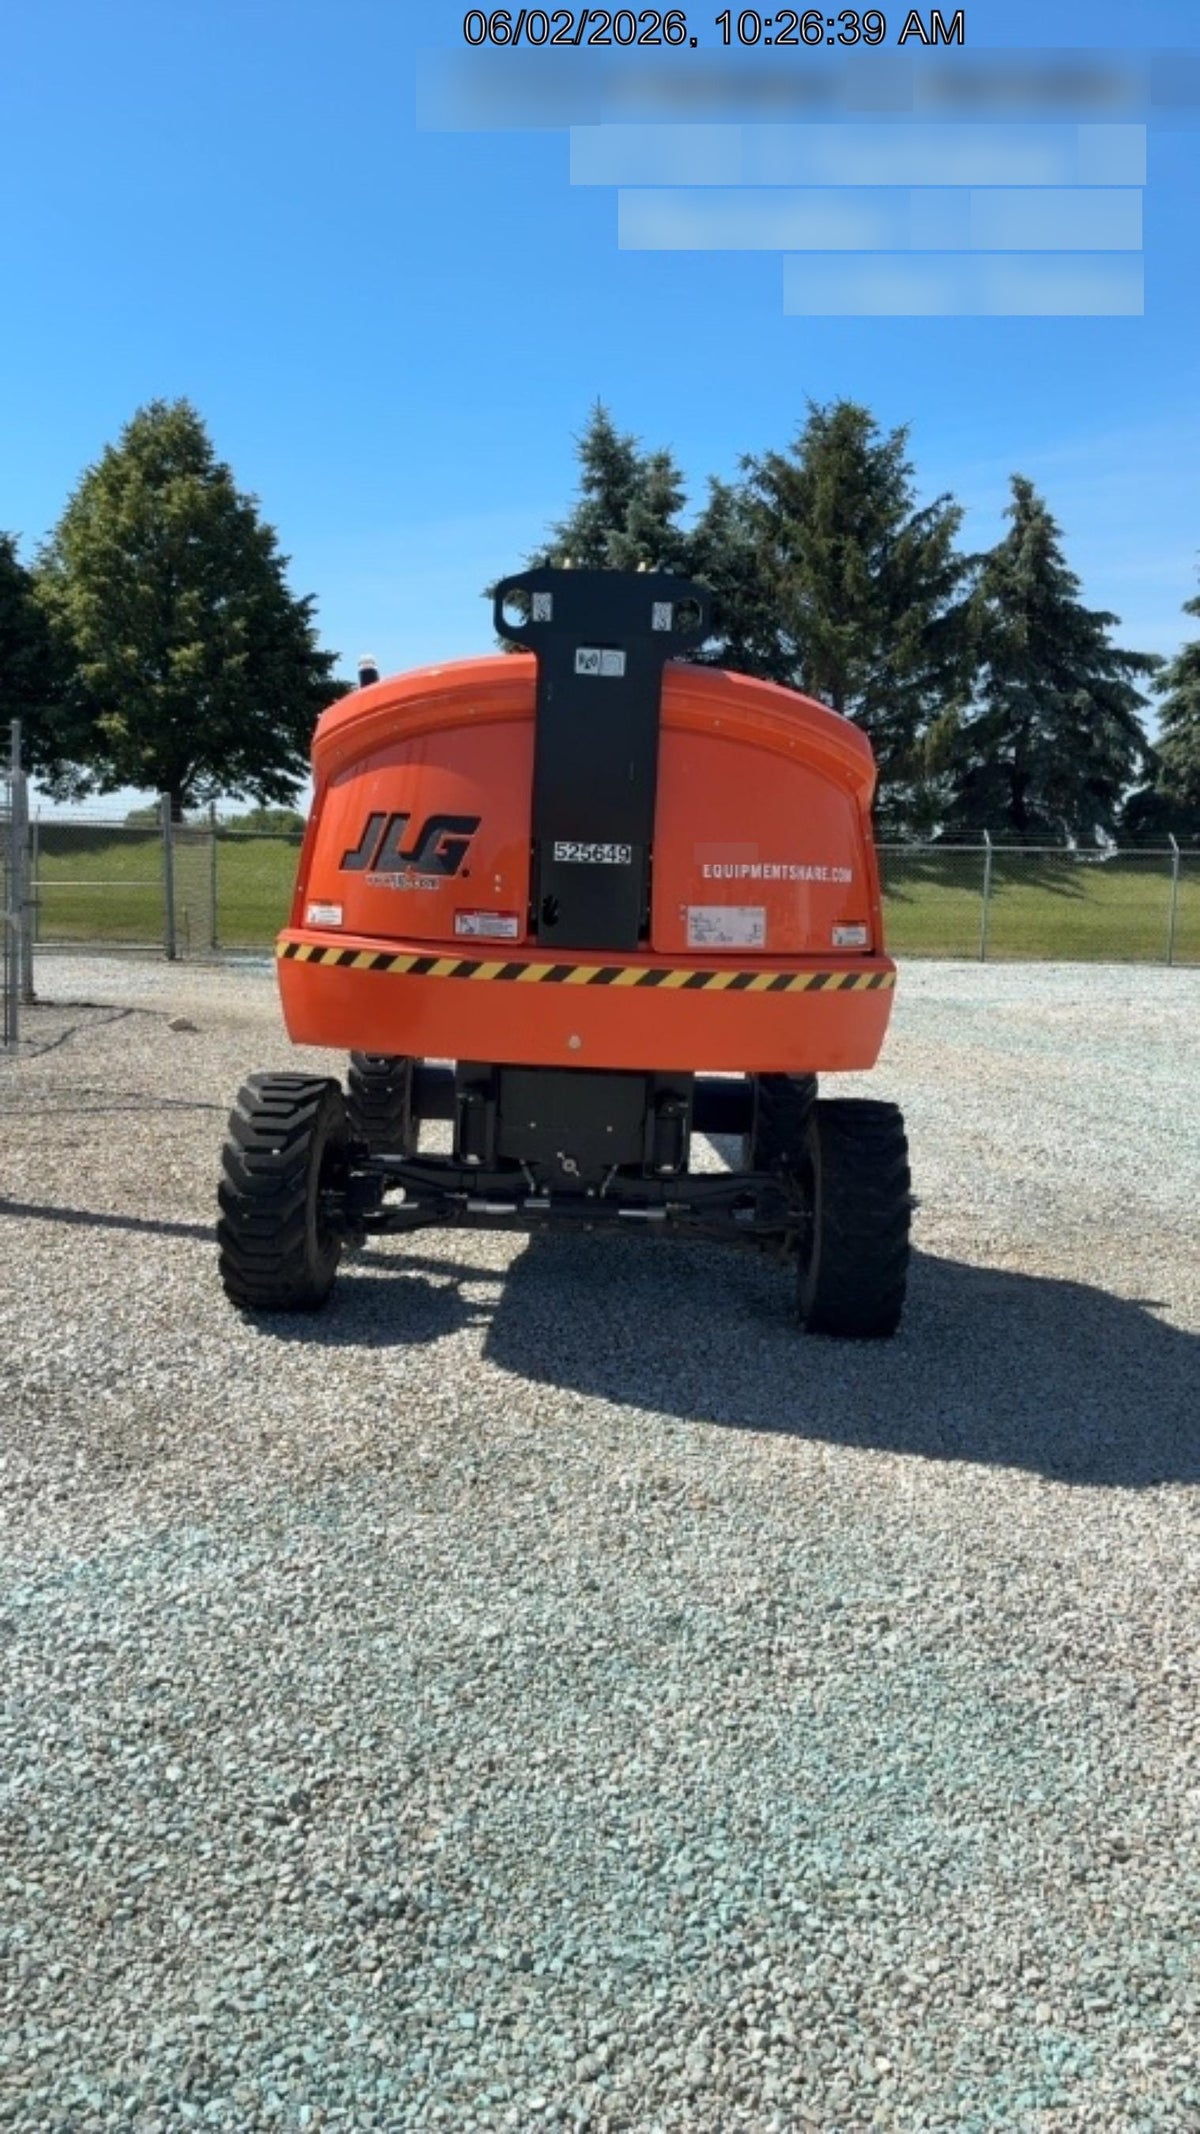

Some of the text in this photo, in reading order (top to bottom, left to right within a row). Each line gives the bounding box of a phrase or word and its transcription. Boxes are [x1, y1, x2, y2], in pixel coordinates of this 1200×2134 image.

[339, 810, 482, 876] JLG
[555, 842, 631, 862] 525649
[702, 863, 852, 883] EQUIPMENTSHARE.COM
